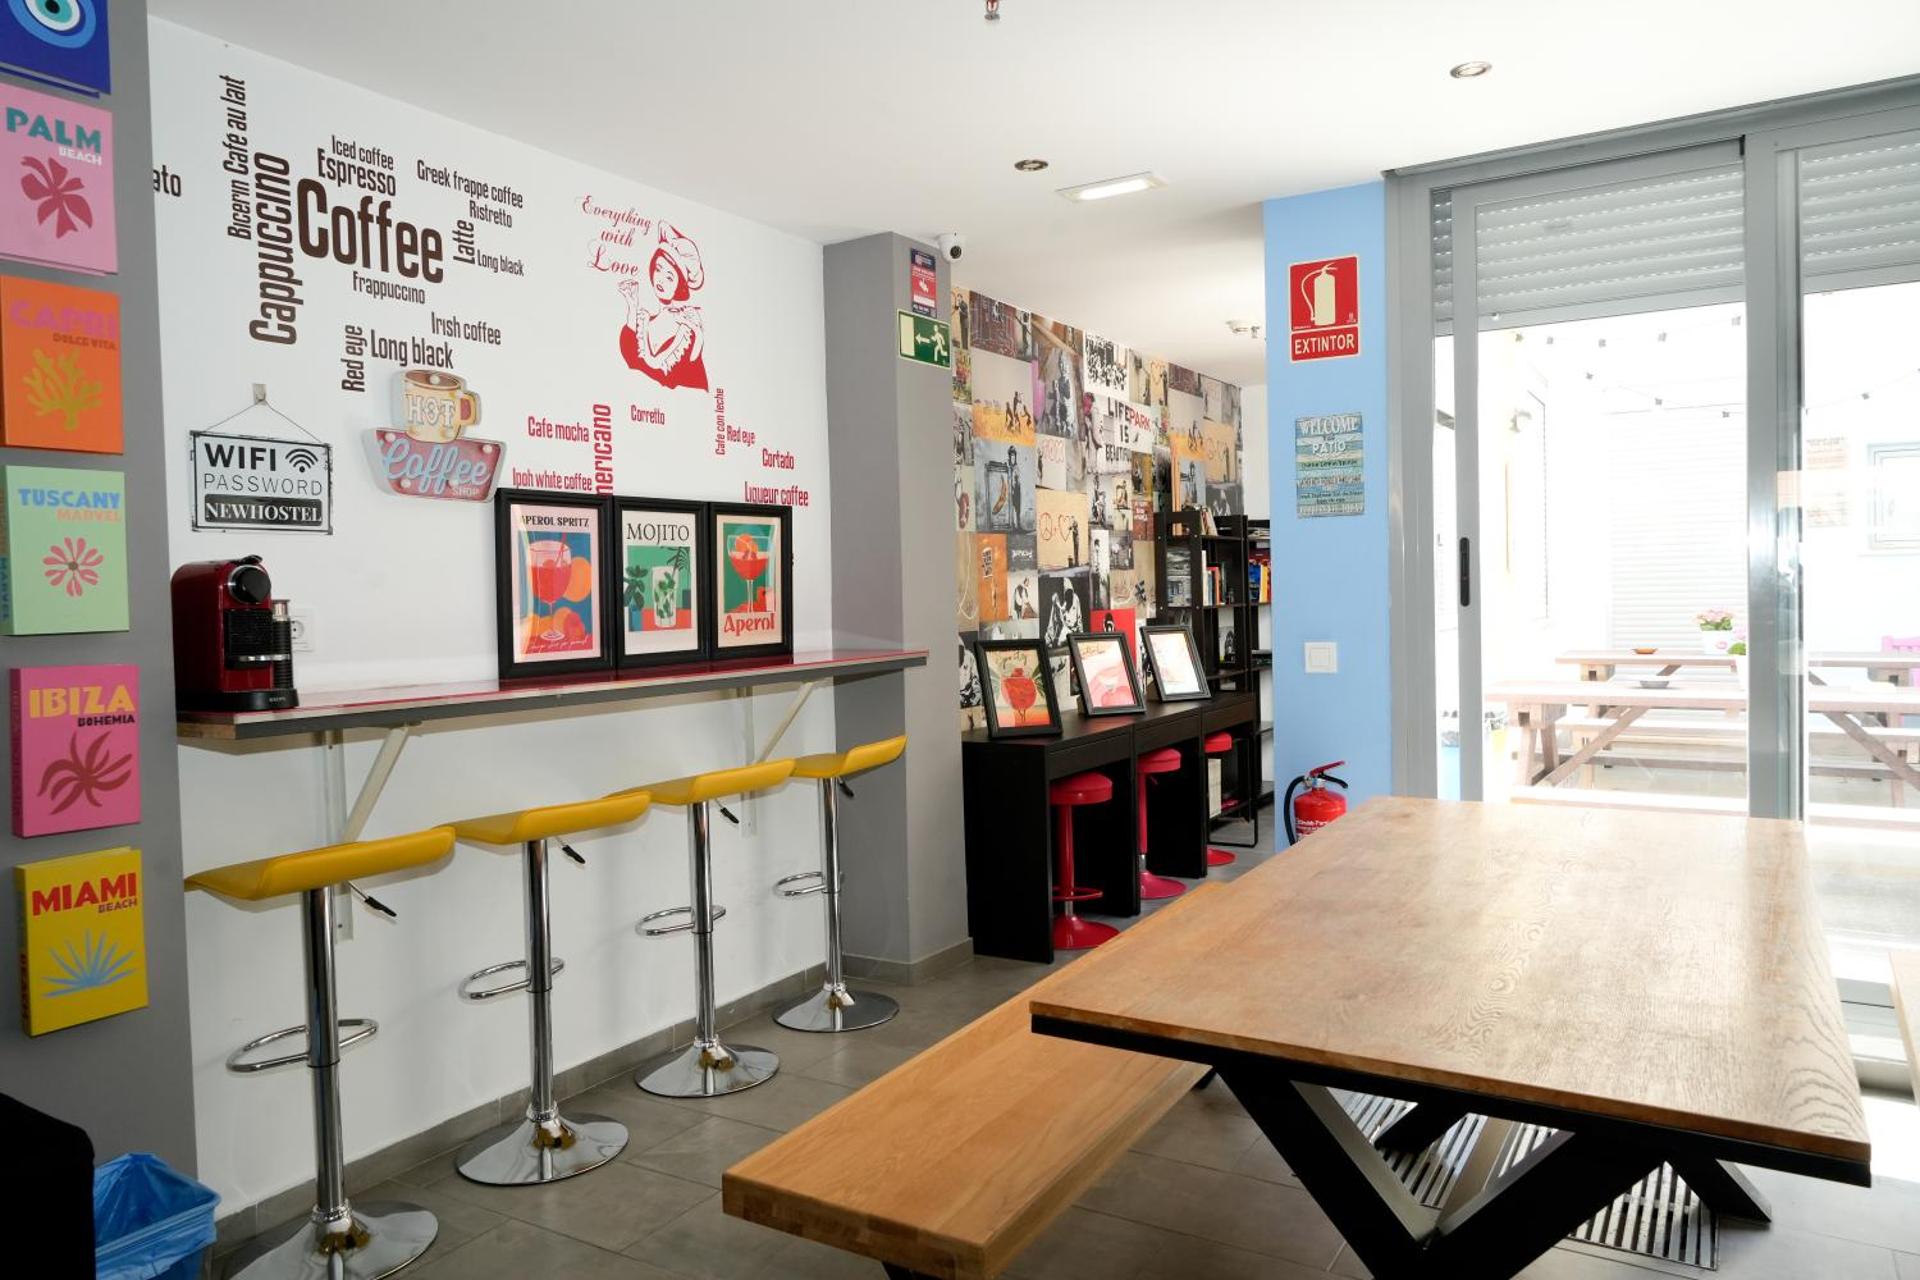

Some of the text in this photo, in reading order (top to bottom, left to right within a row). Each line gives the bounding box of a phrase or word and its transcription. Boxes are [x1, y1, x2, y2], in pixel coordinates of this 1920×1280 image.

[219, 75, 246, 106] lait
[6, 106, 102, 153] PALM
[226, 107, 247, 131] au
[58, 145, 102, 166] BEACH
[331, 135, 394, 170] Iced coffee
[317, 148, 396, 197] Espresso
[417, 159, 451, 188] Greek
[491, 185, 523, 209] coffee
[227, 180, 252, 240] Bicerin
[469, 200, 513, 229] Ristretto
[581, 195, 652, 236] Everything
[297, 177, 443, 284] Coffee
[451, 219, 476, 265] Latte
[600, 227, 636, 247] with
[250, 152, 304, 345] Cappuccino
[587, 243, 639, 276] Love
[477, 249, 525, 277] Long black
[352, 271, 426, 304] Frappuccino
[53, 332, 117, 350] DOLCE VITA
[431, 311, 502, 346] Irish coffee
[371, 329, 454, 370] Long black
[1294, 333, 1355, 355] EXTINTOR
[340, 324, 368, 393] Red eye
[405, 393, 456, 429] HOT
[714, 388, 724, 413] leche
[630, 404, 666, 426] Corretto
[716, 414, 725, 430] con
[1299, 416, 1358, 435] WELCOME
[527, 415, 590, 443] Cafe mocha
[726, 424, 756, 447] Red eye
[204, 442, 277, 472] WIFI
[762, 447, 795, 470] Cortado
[1312, 440, 1346, 454] PATIO
[378, 438, 492, 495] Coffee
[512, 467, 593, 491] Ipoh white coffee
[204, 472, 323, 496] PASSWORD
[780, 485, 809, 507] coffee
[18, 488, 121, 509] TUSCANY
[57, 508, 121, 523] MARVEL
[205, 501, 323, 523] NEWHOSTEL
[557, 517, 590, 527] SPRITZ
[627, 522, 690, 545] MOJITO
[723, 614, 775, 637] Aperol
[29, 684, 136, 719] IBIZA
[77, 714, 136, 728] BOHEMIA
[32, 872, 137, 917] MIAMI
[98, 898, 138, 914] BEACH
